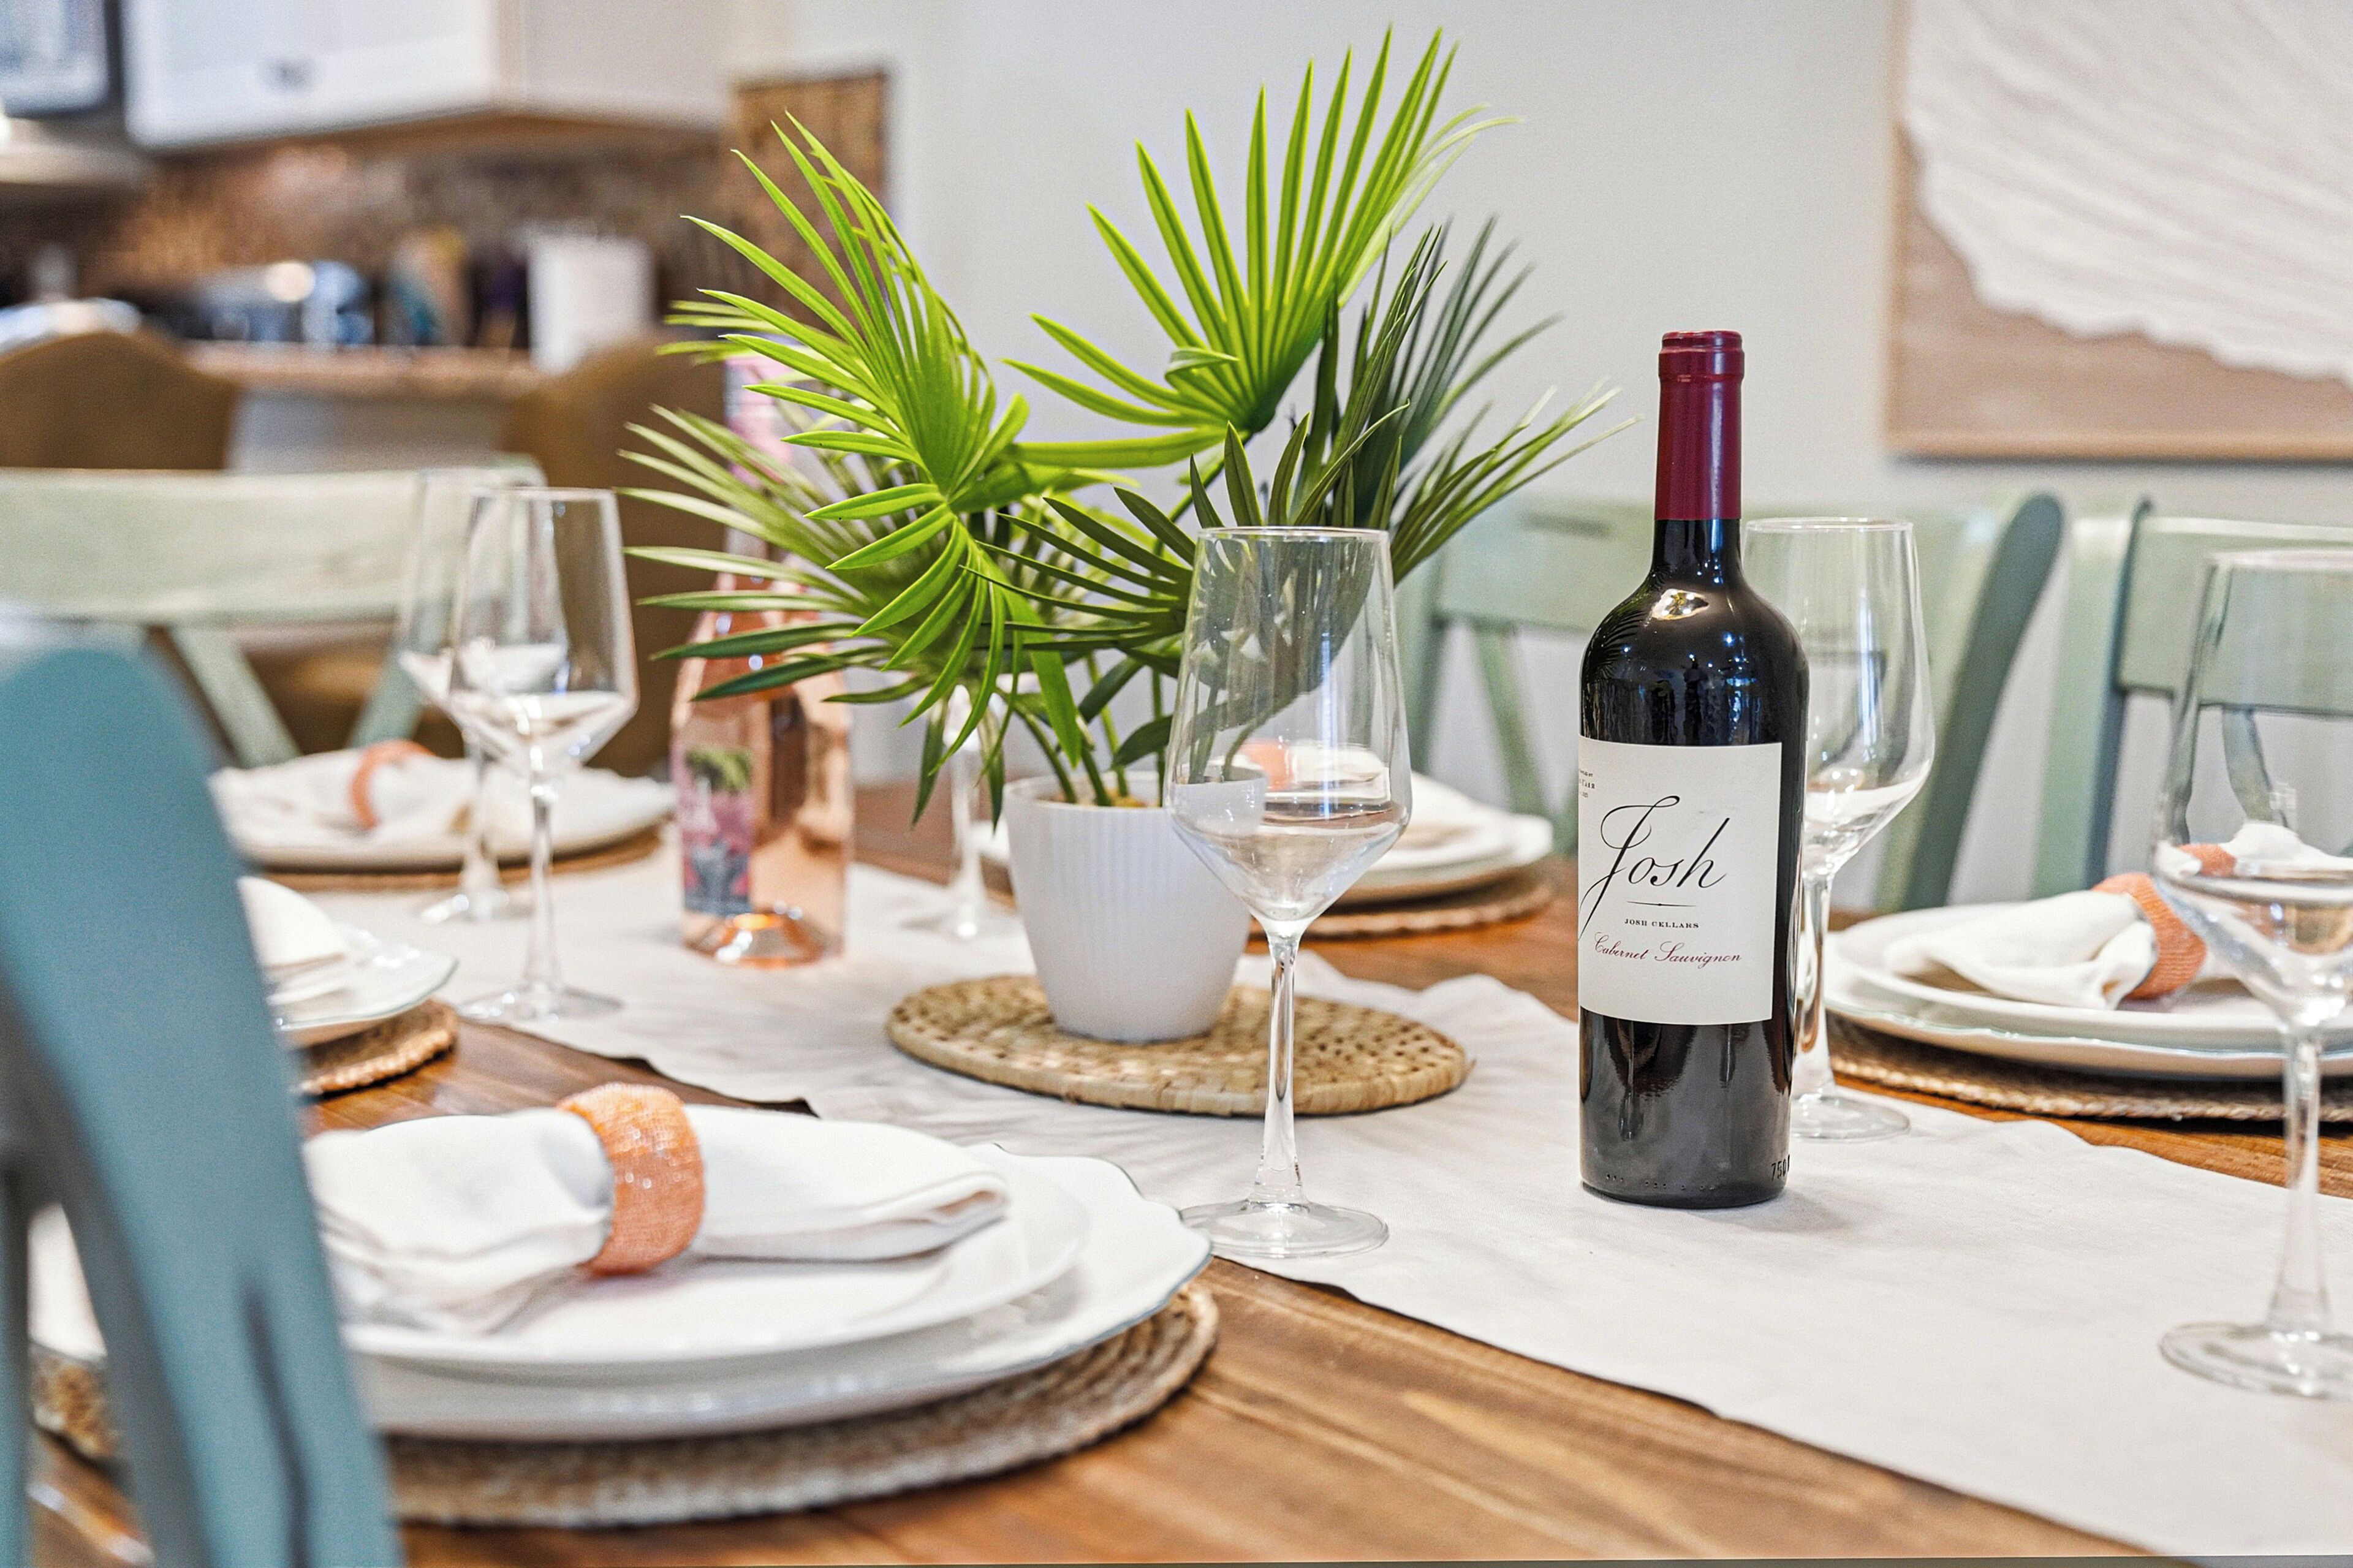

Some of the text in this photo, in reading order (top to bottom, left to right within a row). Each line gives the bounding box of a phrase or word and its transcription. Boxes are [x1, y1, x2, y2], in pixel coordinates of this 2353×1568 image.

[1578, 795, 1730, 941] Josh
[1594, 932, 1742, 969] Cabernet Sauvignon
